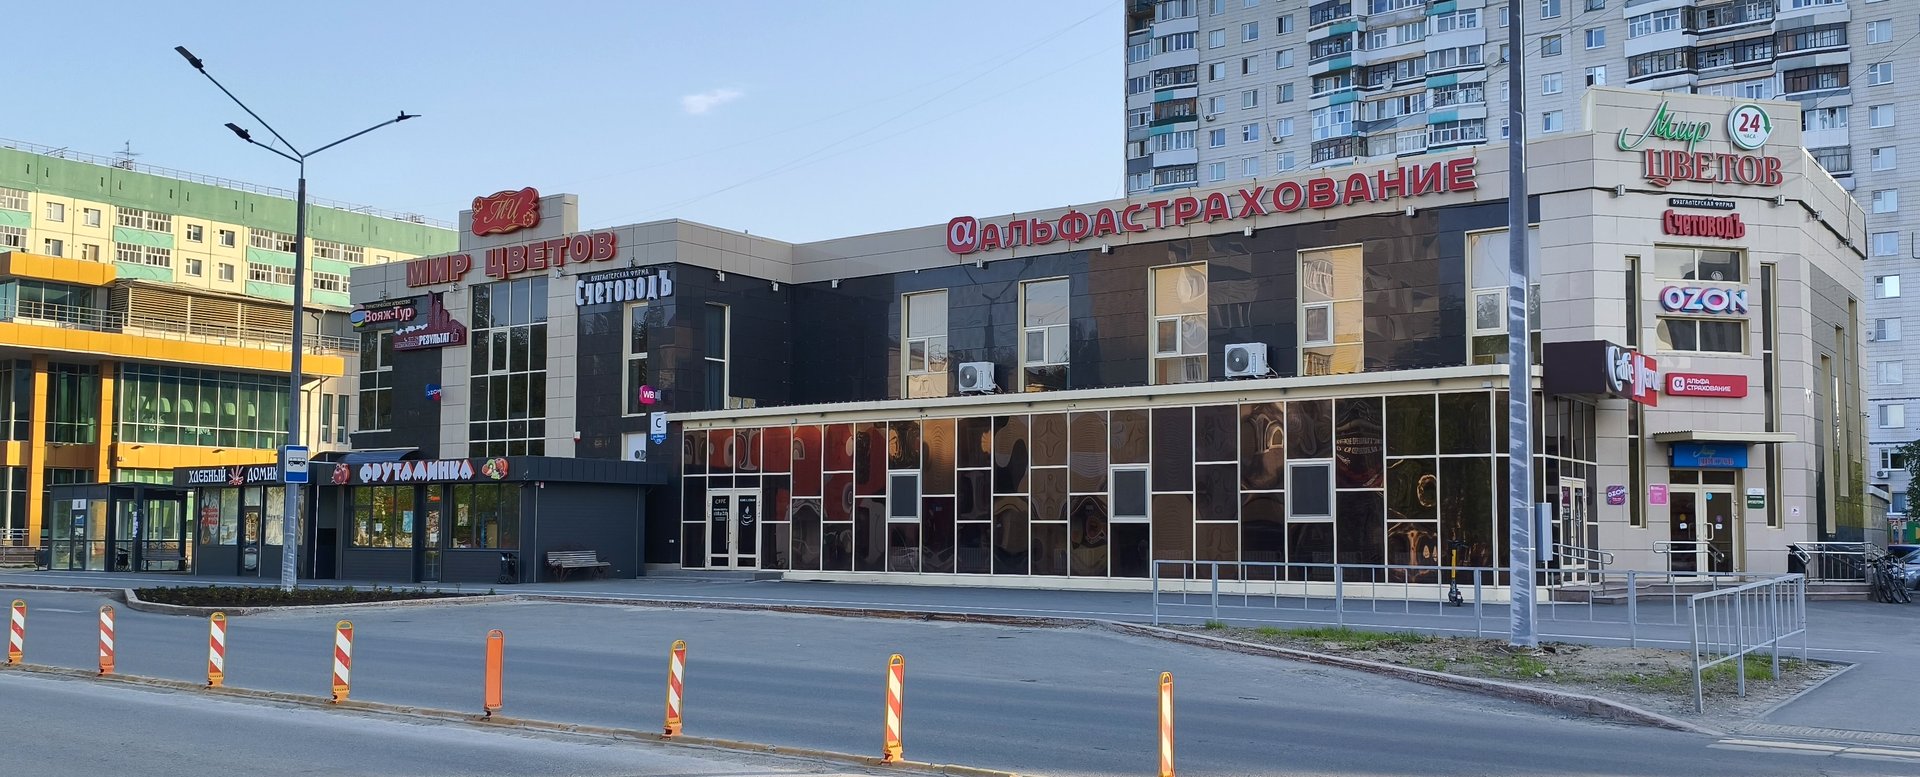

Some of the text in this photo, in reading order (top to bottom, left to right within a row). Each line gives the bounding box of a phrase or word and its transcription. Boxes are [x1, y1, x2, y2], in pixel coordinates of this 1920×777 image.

[1617, 100, 1712, 157] Мир
[1738, 113, 1760, 133] 24
[1644, 148, 1783, 187] ЦВЕТОВ
[980, 156, 1479, 251] АЛЬФАСТРАХОВАНИЕ
[1673, 199, 1714, 207] БУХГАЛТЕРСКАЯ
[406, 231, 617, 288] МИР ЦВЕТОВ
[590, 268, 649, 281] БУХГАЛТЕРСКАЯ ФИРМА
[1660, 286, 1747, 314] OZON
[364, 306, 412, 323] Вояж-Тур
[419, 331, 450, 346] РЕЗУЛЬТАТ
[643, 390, 654, 399] WB
[1686, 384, 1731, 392] СТРАХОВАНИЕ
[188, 466, 278, 484] ХЛЕБНЫЙ ДОМИК
[359, 458, 475, 484] ФРУТАМИНКА
[1608, 488, 1625, 498] OZON
